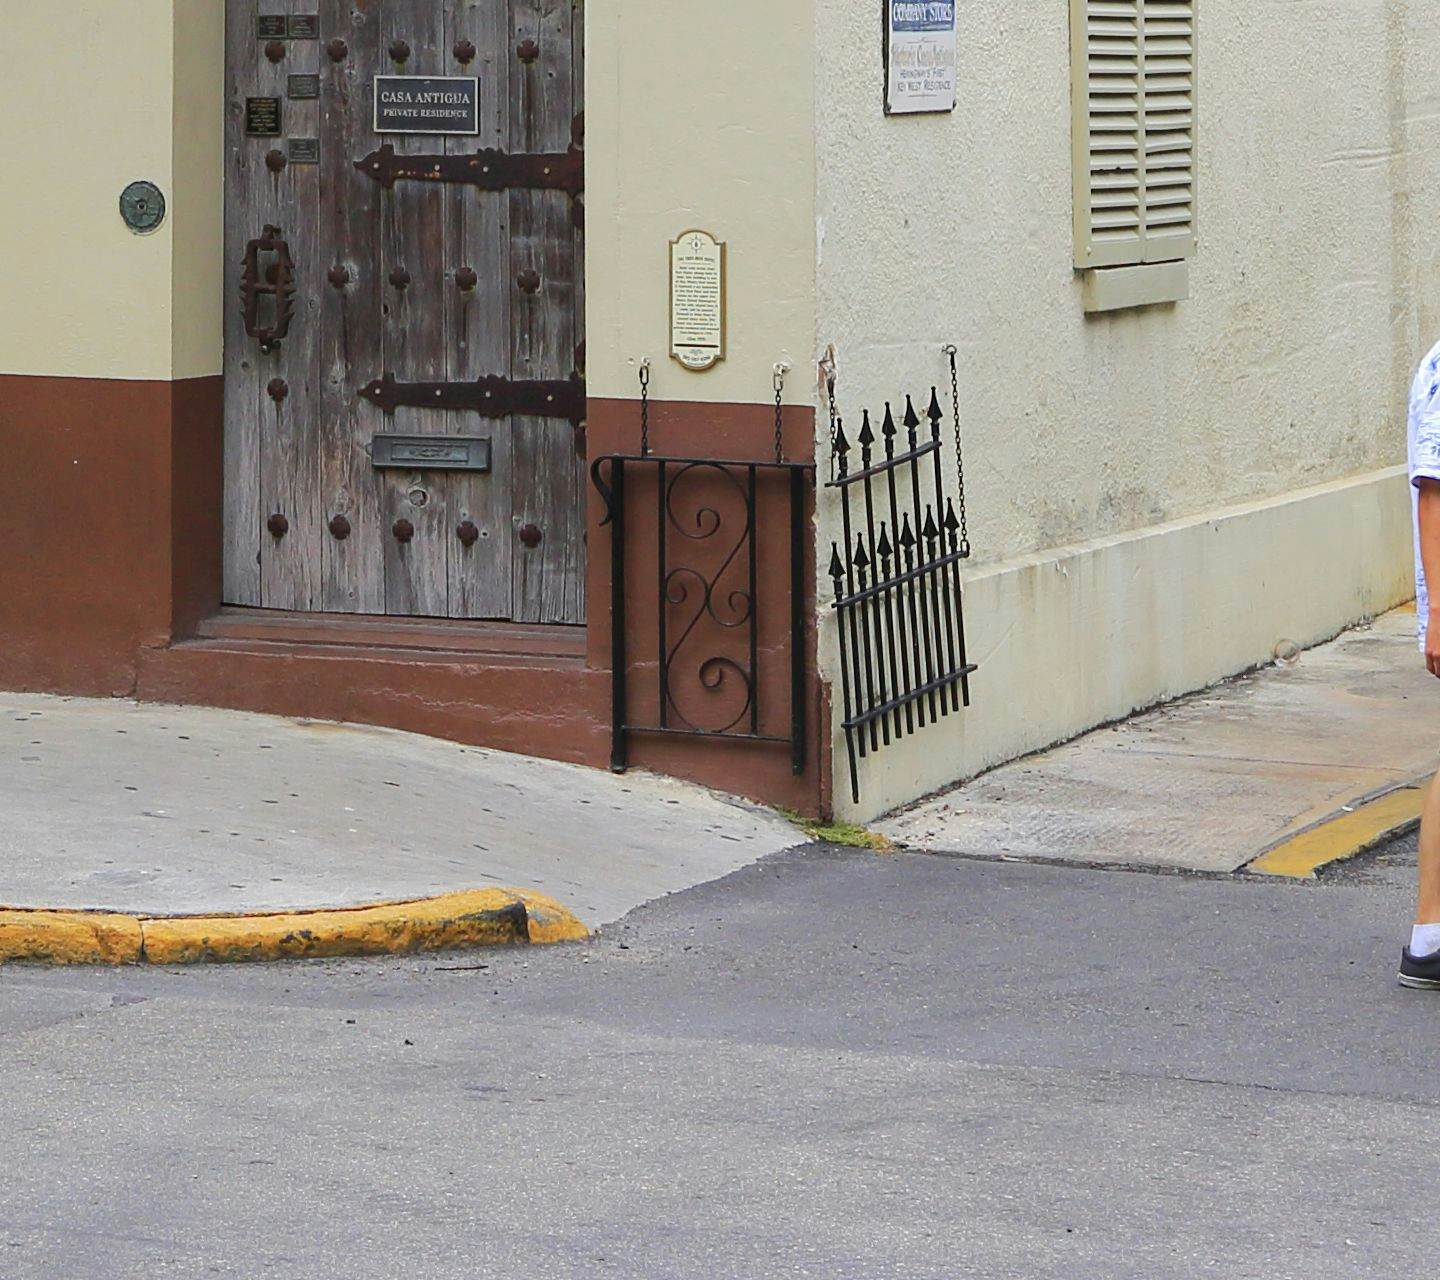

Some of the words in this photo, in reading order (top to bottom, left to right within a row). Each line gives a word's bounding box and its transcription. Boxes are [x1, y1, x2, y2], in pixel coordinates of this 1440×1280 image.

[381, 92, 412, 103] CASA
[414, 92, 470, 104] ANTIGUA
[383, 108, 418, 117] PRIVATE
[420, 108, 468, 118] RESIDENCE
